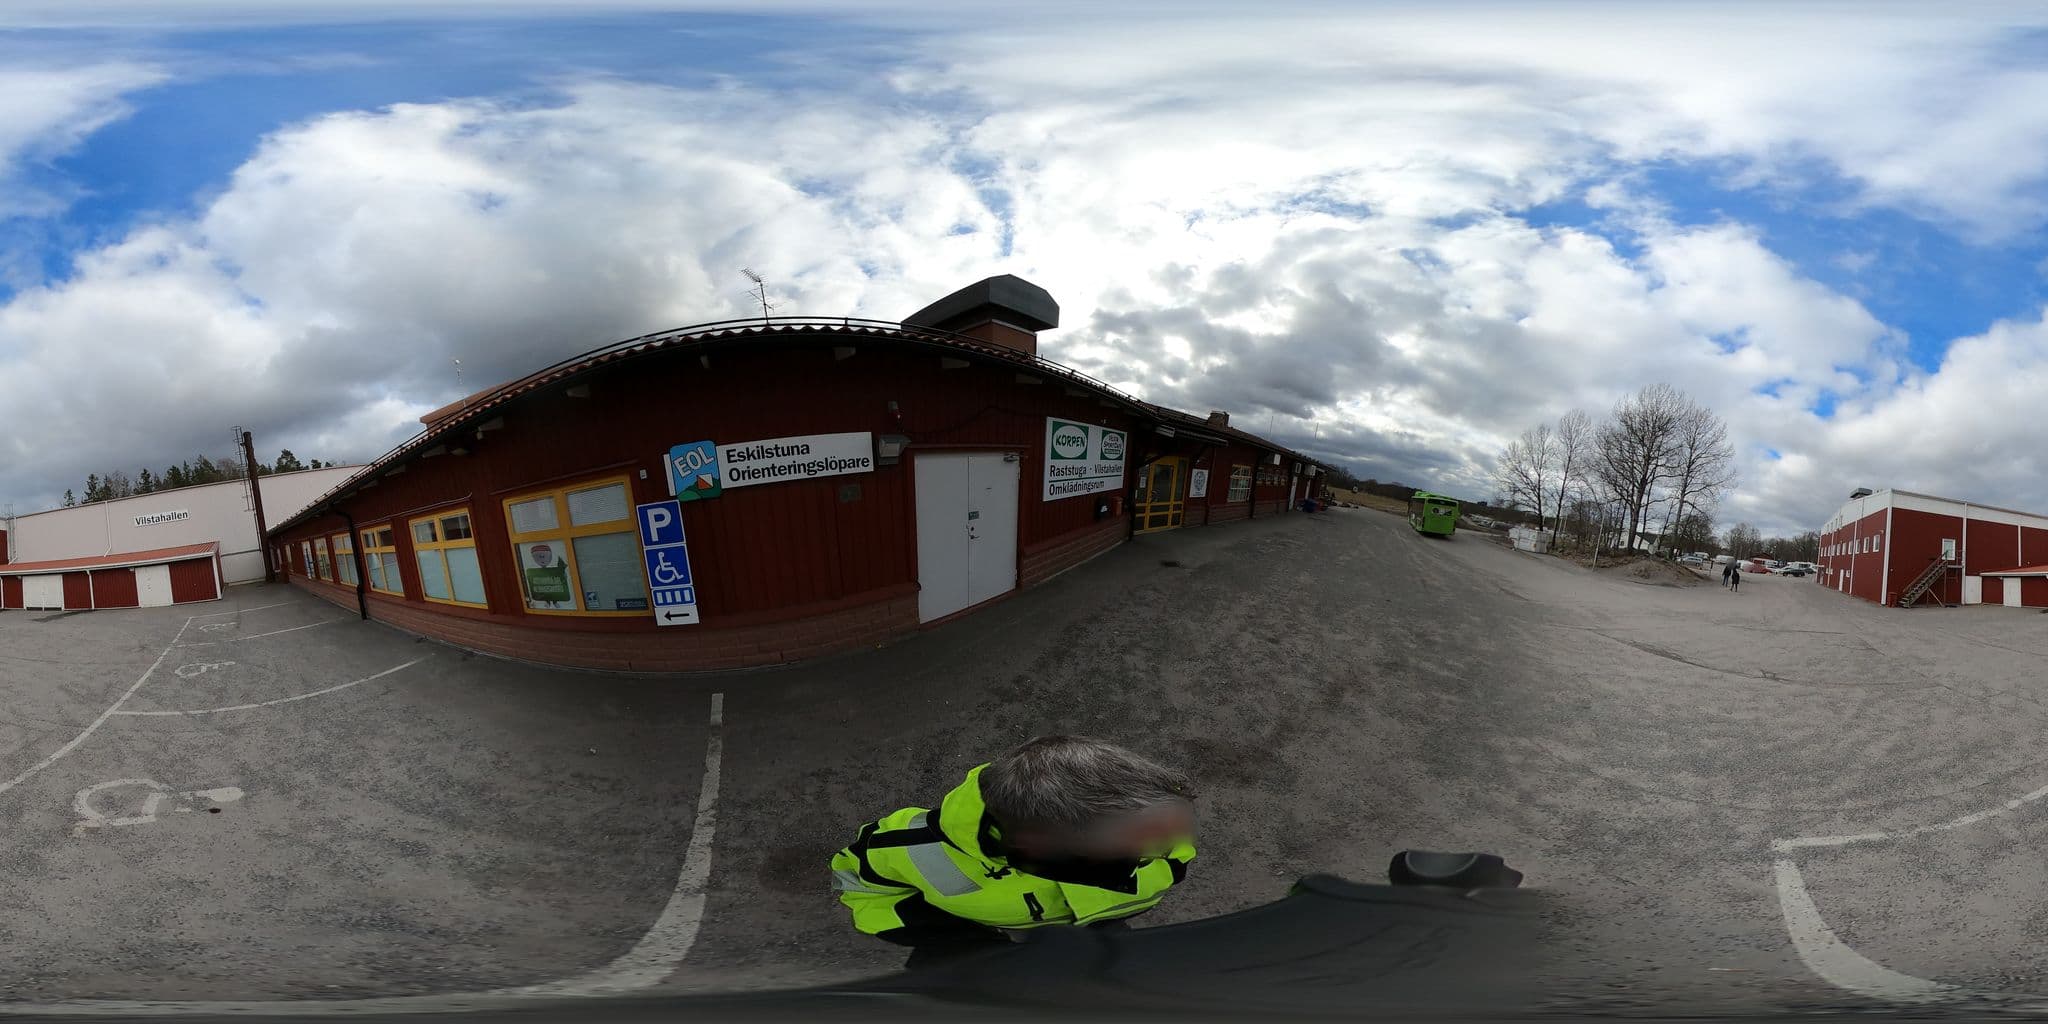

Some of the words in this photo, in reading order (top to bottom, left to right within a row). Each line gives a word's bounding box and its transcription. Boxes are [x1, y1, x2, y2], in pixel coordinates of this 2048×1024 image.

[1055, 434, 1086, 448] KORPEN
[673, 446, 714, 478] EOL
[726, 444, 810, 464] Eskilstuna
[729, 456, 870, 482] Orienteringslöpare
[1050, 464, 1087, 477] Raststuga
[1049, 480, 1105, 496] Omklädningsrum
[135, 512, 188, 525] Vilstahallen
[647, 508, 672, 542] P
